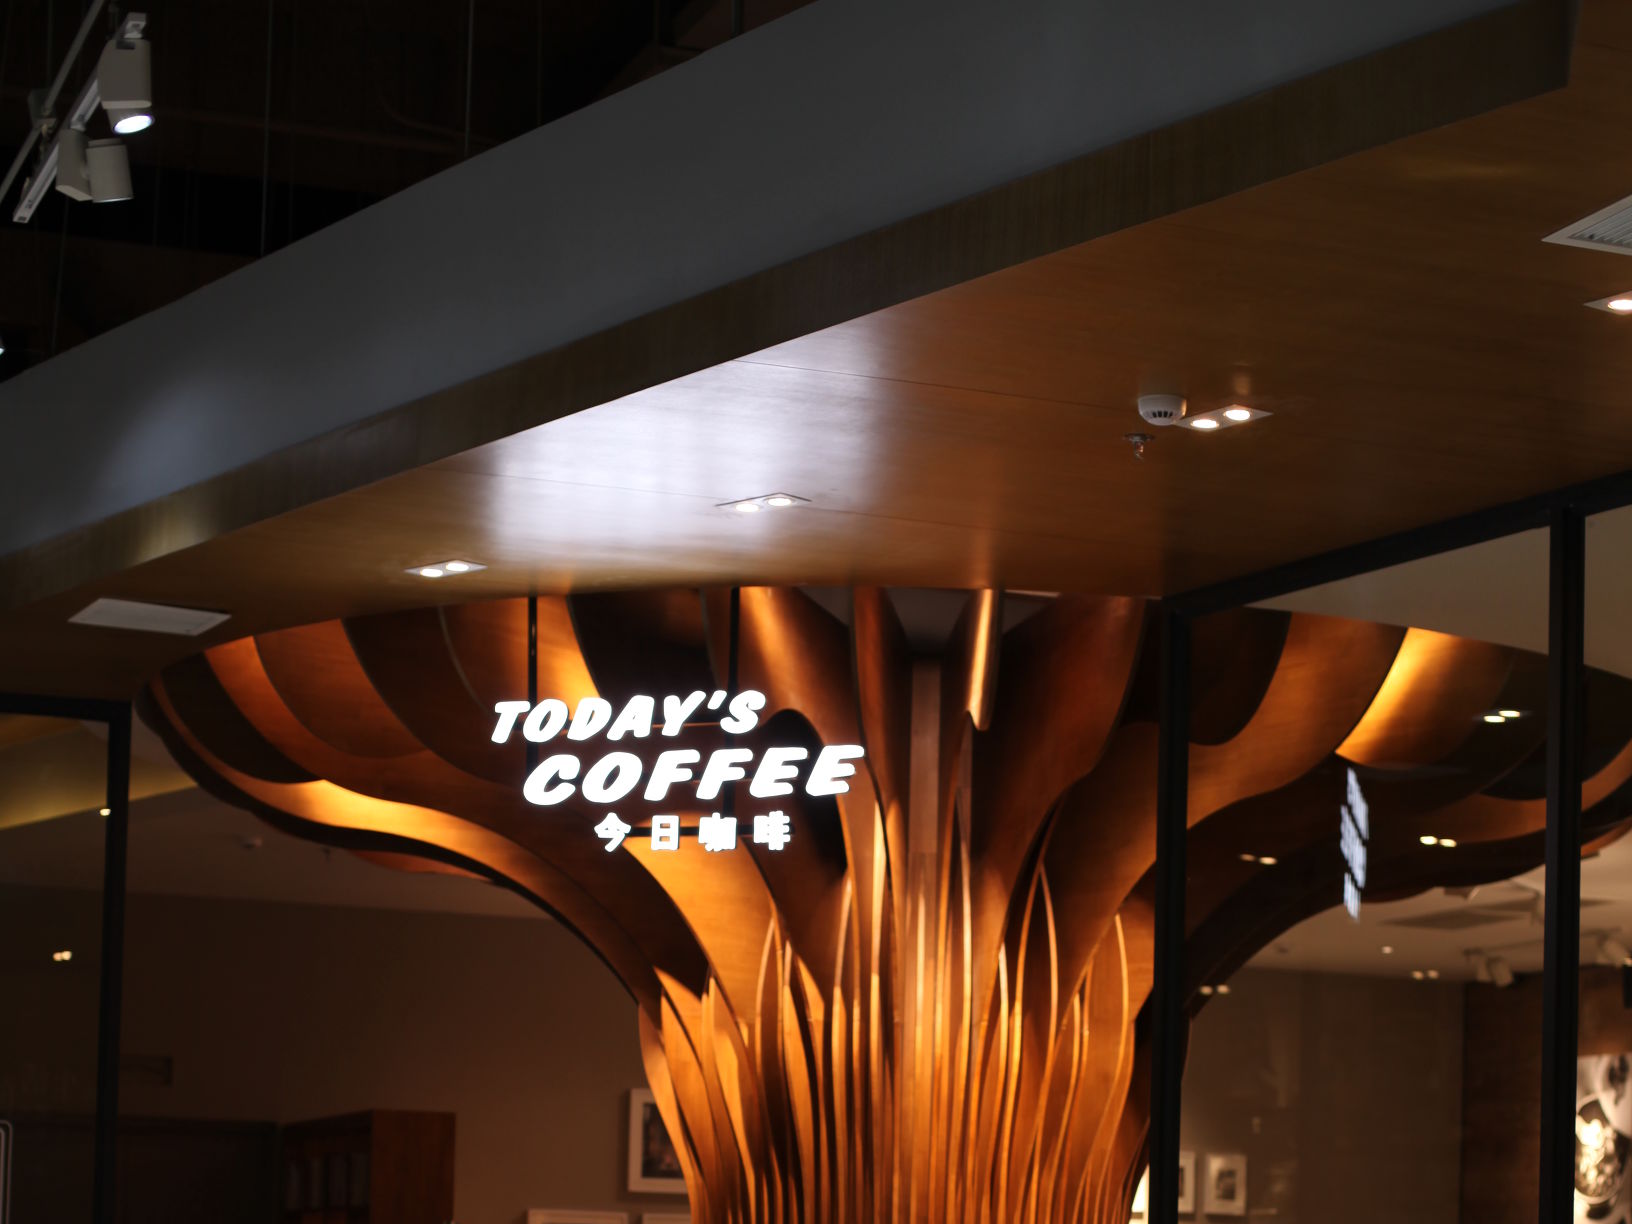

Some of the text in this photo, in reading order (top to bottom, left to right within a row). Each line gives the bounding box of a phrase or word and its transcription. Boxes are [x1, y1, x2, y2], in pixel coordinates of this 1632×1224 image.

[491, 689, 767, 744] TODAY'S
[522, 744, 866, 806] COFFEE
[593, 810, 792, 853] 今日咖啡
